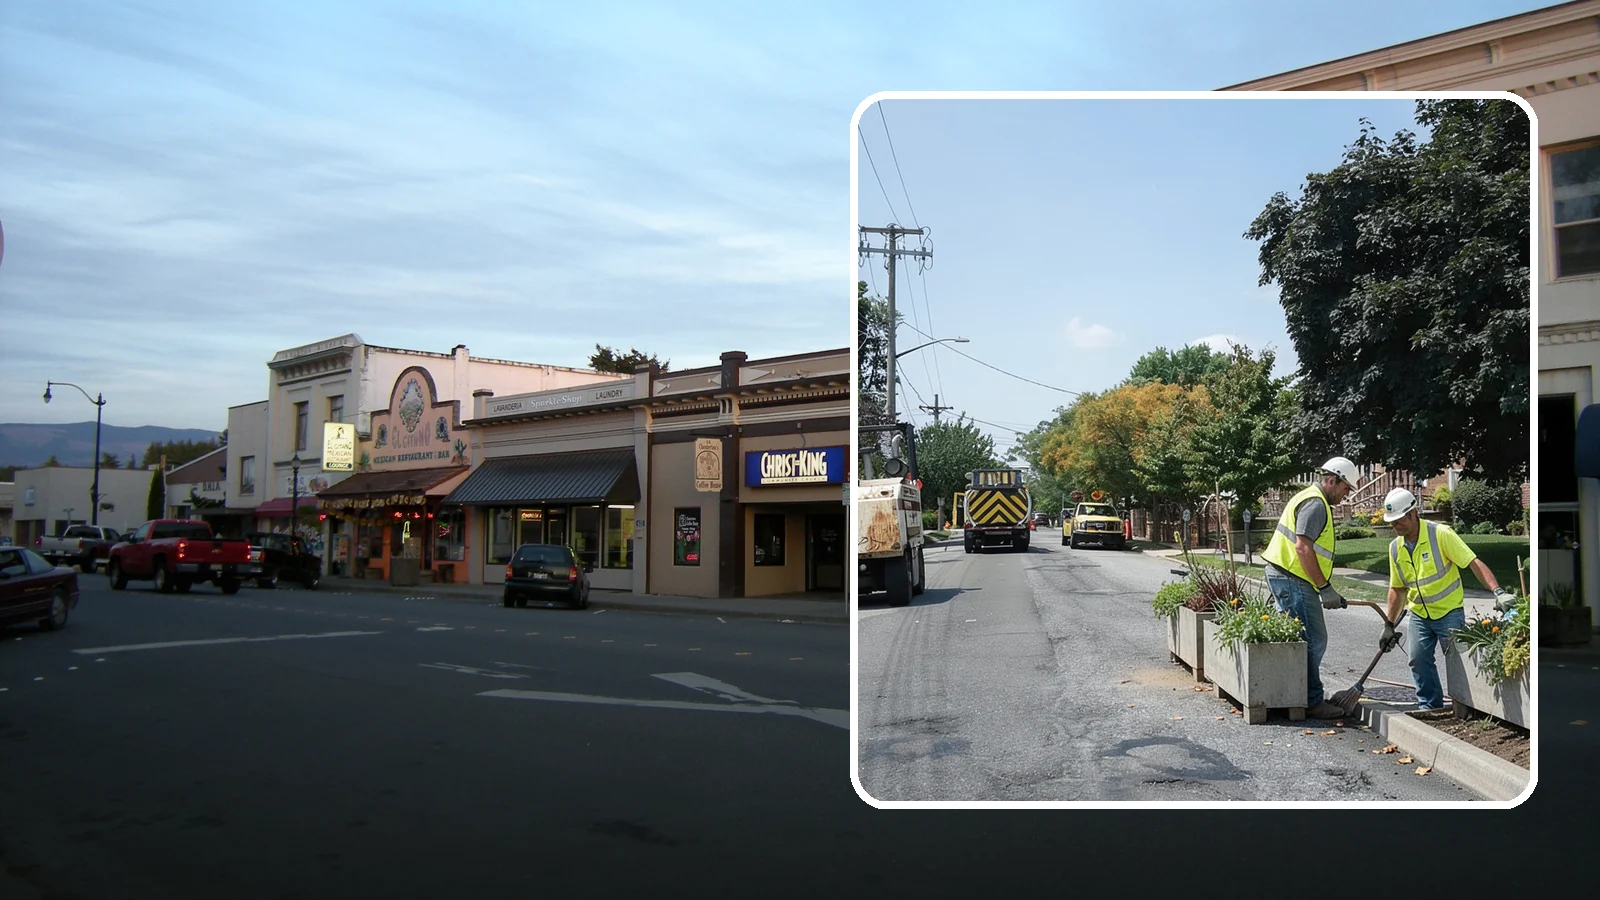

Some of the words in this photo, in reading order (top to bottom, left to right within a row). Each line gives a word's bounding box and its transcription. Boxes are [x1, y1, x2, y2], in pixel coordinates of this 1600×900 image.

[562, 394, 583, 405] Shop
[595, 389, 623, 400] LAUNDRY
[493, 402, 523, 412] LAVANDERIA
[373, 455, 396, 464] MEXICAN
[397, 451, 433, 462] RESTAURANT
[438, 450, 450, 459] BAR
[760, 452, 797, 478] CHRIST
[799, 450, 827, 476] KING
